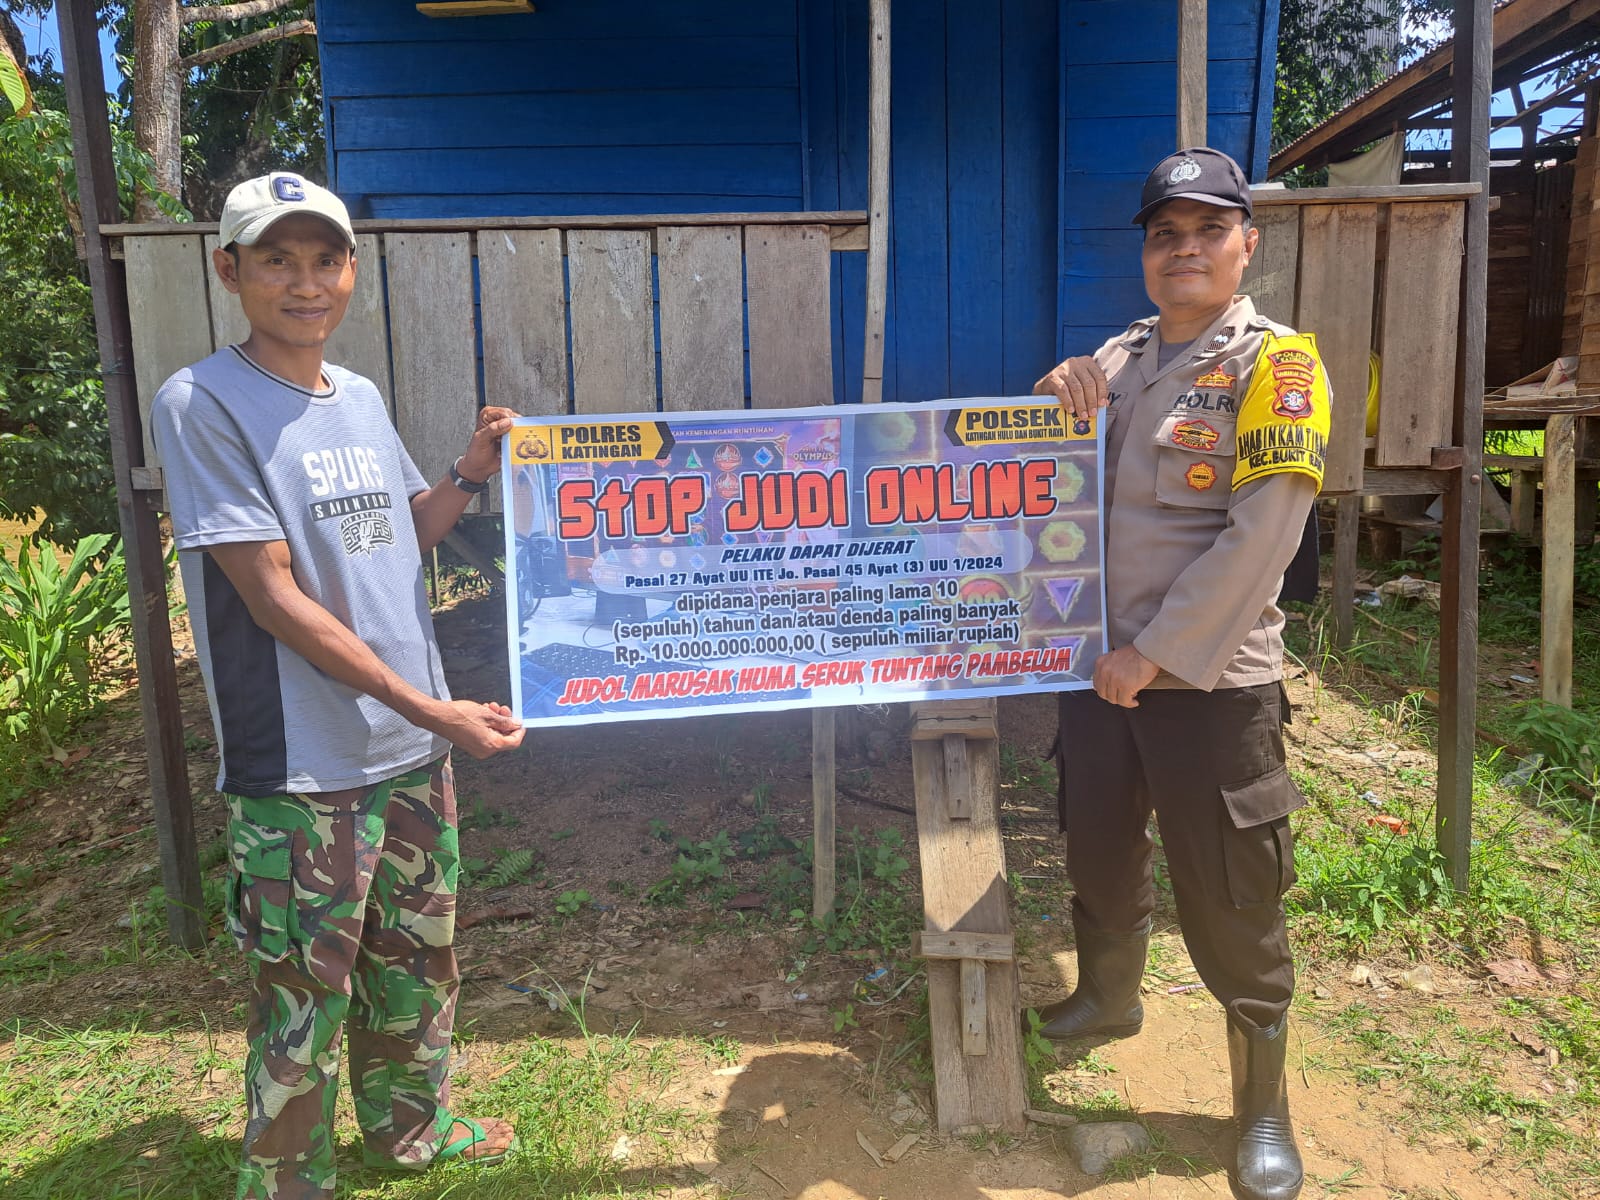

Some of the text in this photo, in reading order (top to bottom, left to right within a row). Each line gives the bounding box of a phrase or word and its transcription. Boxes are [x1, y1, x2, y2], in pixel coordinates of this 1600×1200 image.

[966, 408, 1061, 430] POLSEK
[561, 425, 641, 445] POLRES
[965, 427, 1065, 442] KATINGAN HULU DAN BUKIT RAYA
[562, 444, 642, 460] KATINGAN
[793, 451, 834, 462] OLYMPUS
[302, 446, 384, 496] SPURS
[725, 469, 849, 533] JUDI
[866, 458, 1058, 526] ONLINE
[722, 539, 916, 563] PELAKU DAPAT DIJERAT
[625, 557, 1003, 587] Pasal 27 Ayat UU ITE Jo. Pasal 45 Ayat (3) UU 1/2024
[677, 580, 958, 613] dipidana penjara paling lama 10
[613, 600, 1021, 643] (sepuluh) tahun dan/atau denda paling banyak
[615, 647, 646, 666] Rp.
[651, 633, 815, 660] 10.000.000.000,00
[831, 630, 899, 651] sepuluh
[904, 627, 955, 645] miliar
[959, 623, 1021, 644] rupiah)
[557, 647, 1073, 705] JUDOL MARUSAK HUMA SERUK TUNTANG PAMBELUM
